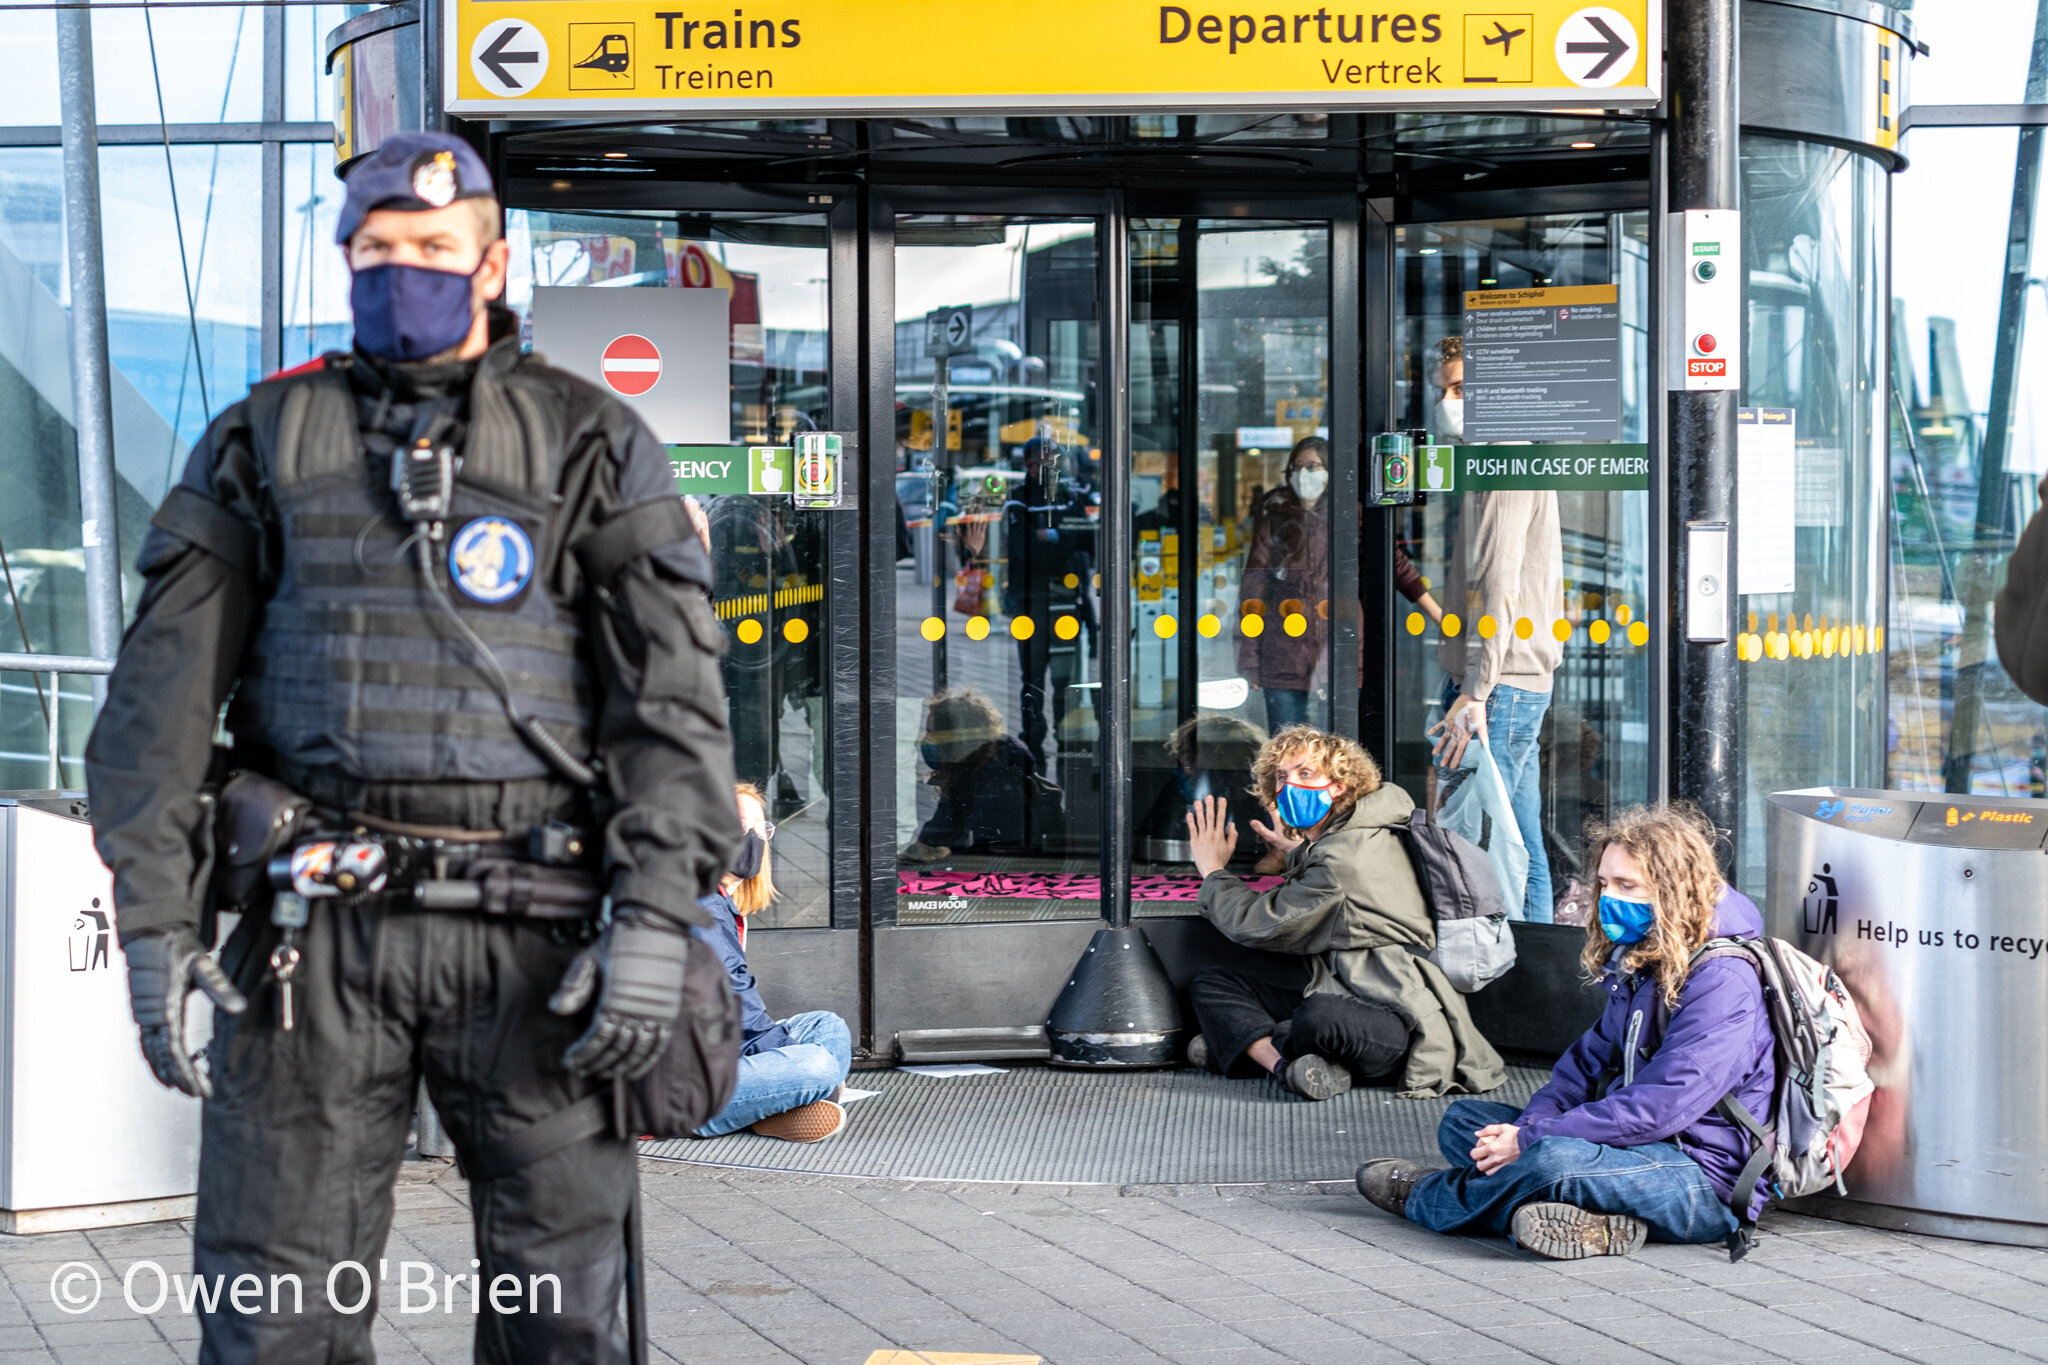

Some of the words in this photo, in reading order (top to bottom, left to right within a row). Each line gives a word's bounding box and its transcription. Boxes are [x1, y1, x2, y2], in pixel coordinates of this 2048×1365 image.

[655, 12, 801, 50] Trains
[1159, 6, 1442, 54] Departures
[655, 65, 773, 89] Treinen
[1322, 58, 1442, 84] Vertrek
[1518, 290, 1545, 298] Schiphol
[1691, 362, 1724, 373] STOP
[1466, 458, 1507, 475] PUSH
[1511, 458, 1527, 475] IN
[1530, 457, 1571, 475] CASE
[1574, 457, 1597, 475] OF
[1979, 811, 2033, 824] Plastic
[1857, 919, 1909, 948] Help
[1919, 929, 1944, 947] us
[1953, 929, 1979, 949] to
[1990, 935, 2048, 960] recy
